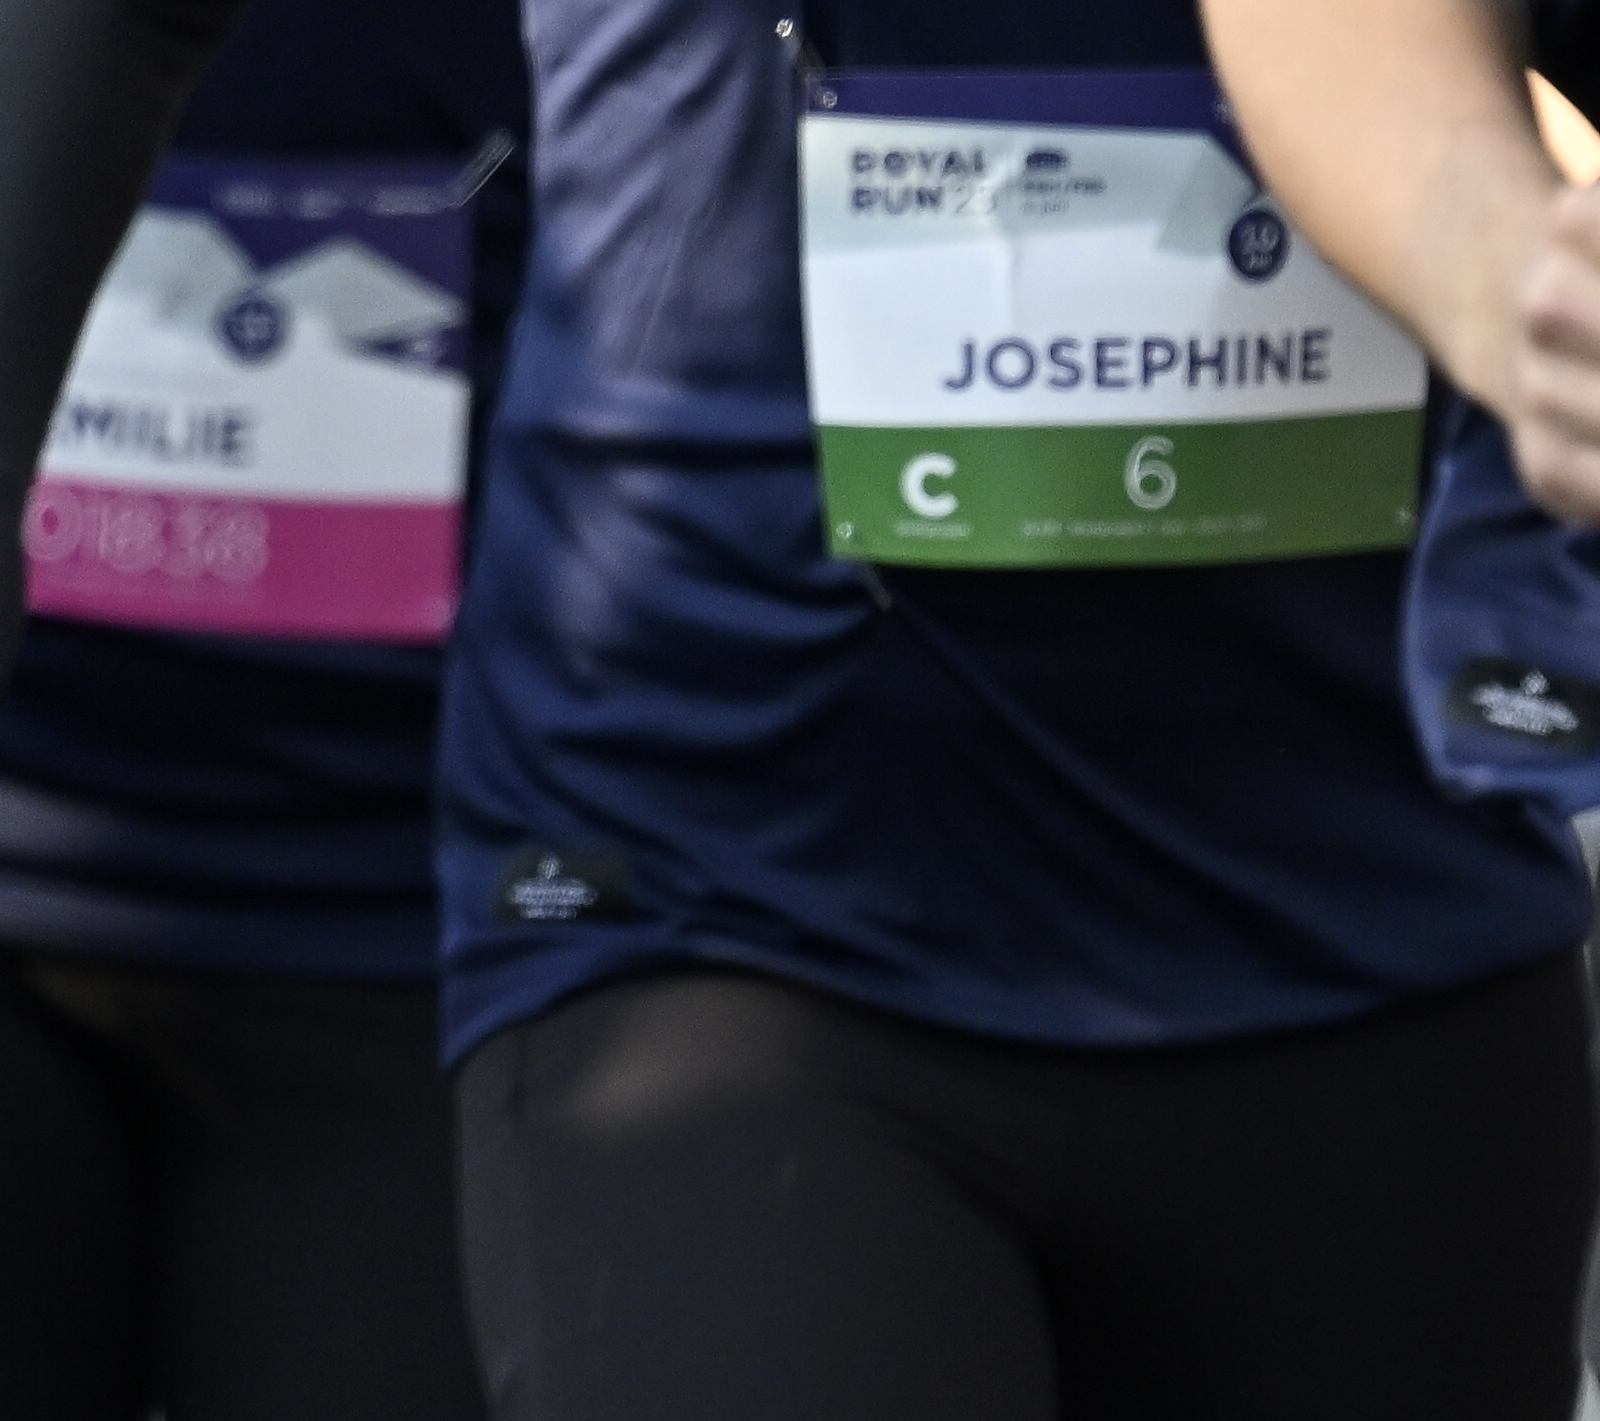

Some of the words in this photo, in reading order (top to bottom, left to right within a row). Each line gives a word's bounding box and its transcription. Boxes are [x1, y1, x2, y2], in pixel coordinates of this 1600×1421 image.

[942, 327, 1332, 392] JOSEPHINE
[56, 400, 258, 468] MILIE
[901, 451, 959, 519] C
[1123, 435, 1178, 510] 6
